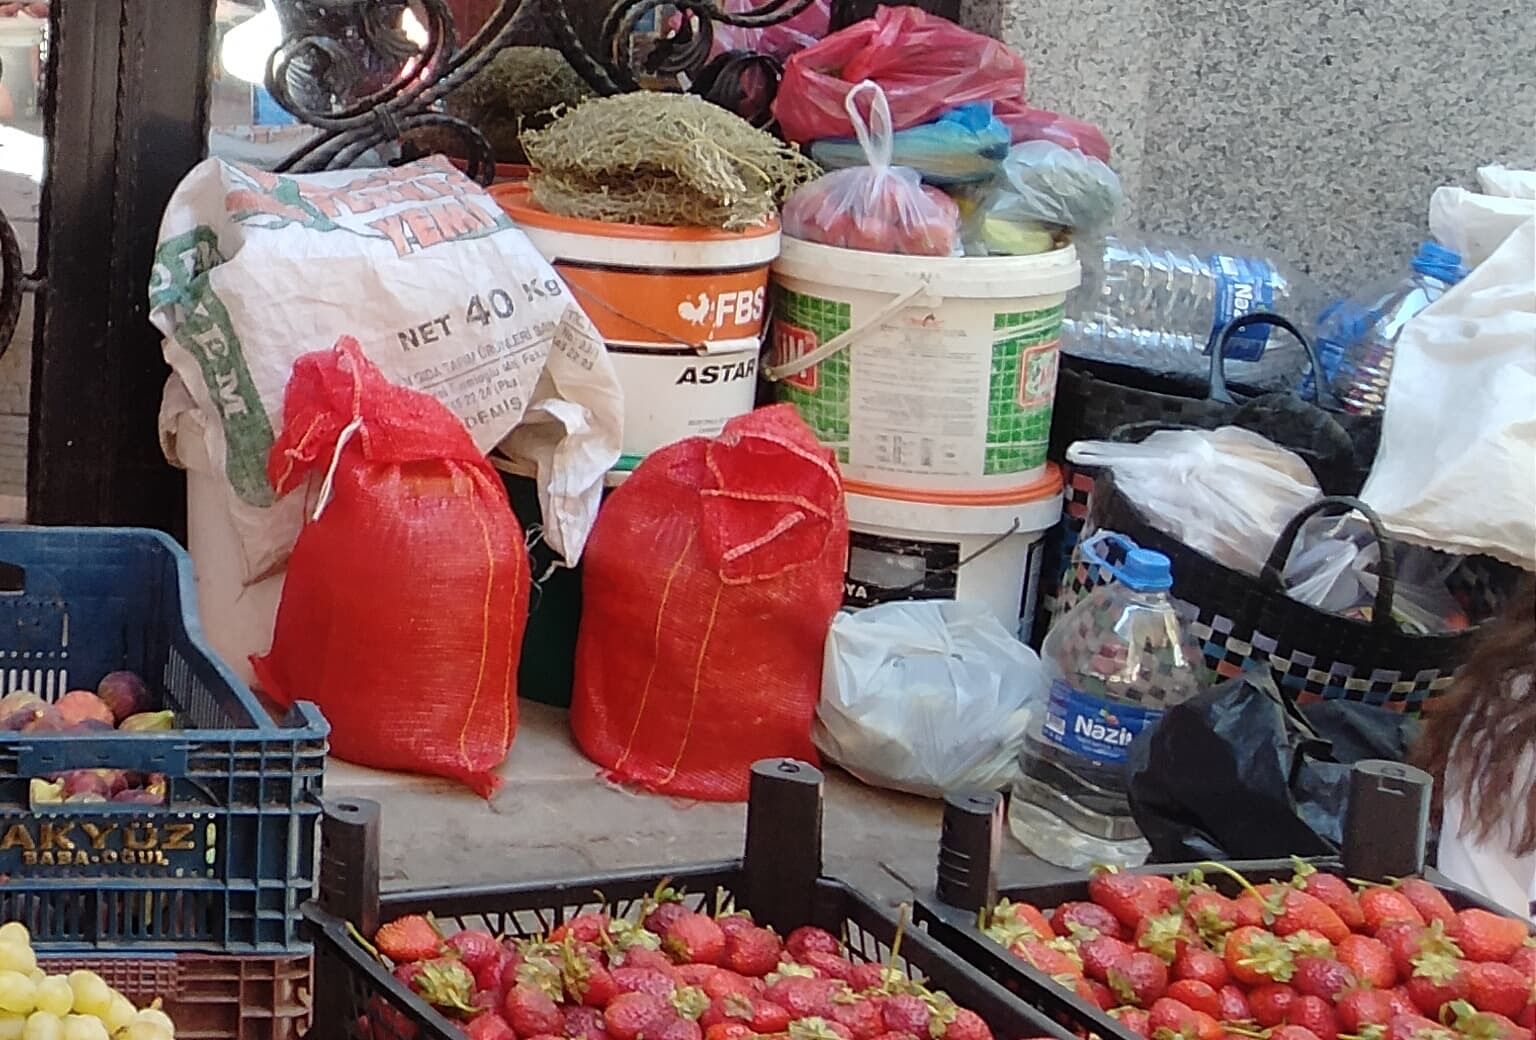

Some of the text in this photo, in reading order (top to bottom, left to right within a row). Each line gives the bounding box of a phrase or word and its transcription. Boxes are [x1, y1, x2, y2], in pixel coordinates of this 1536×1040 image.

[397, 278, 562, 353] NET 40 Kg
[716, 286, 765, 327] FBS
[676, 358, 756, 385] ASTAR
[0, 821, 195, 851] AKYÜZ
